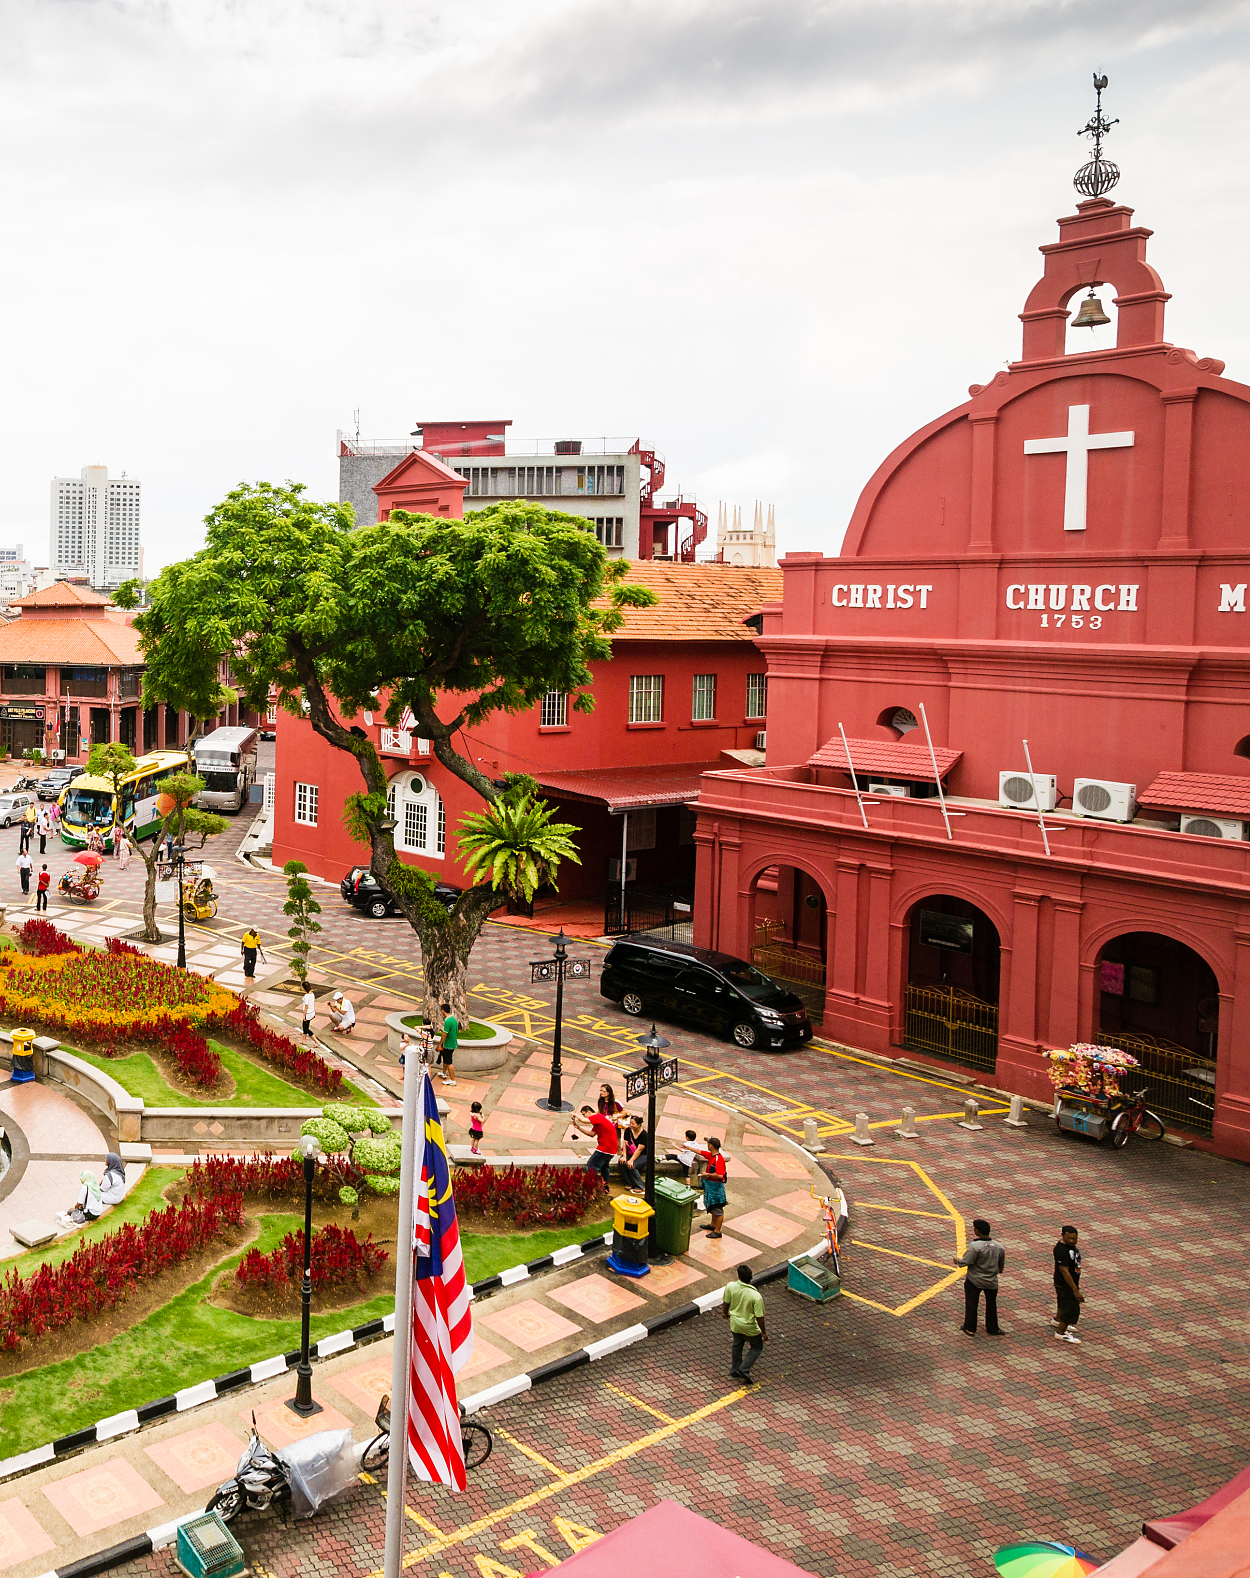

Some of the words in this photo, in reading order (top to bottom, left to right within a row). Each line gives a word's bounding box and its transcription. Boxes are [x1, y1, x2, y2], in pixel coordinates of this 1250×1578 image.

[832, 585, 932, 608] CHRIST
[1006, 584, 1139, 610] CHURCH
[1218, 584, 1247, 611] M
[1041, 614, 1102, 629] 1753
[349, 946, 424, 975] HAJA
[471, 983, 551, 1010] BECA
[565, 1014, 646, 1043] HAS
